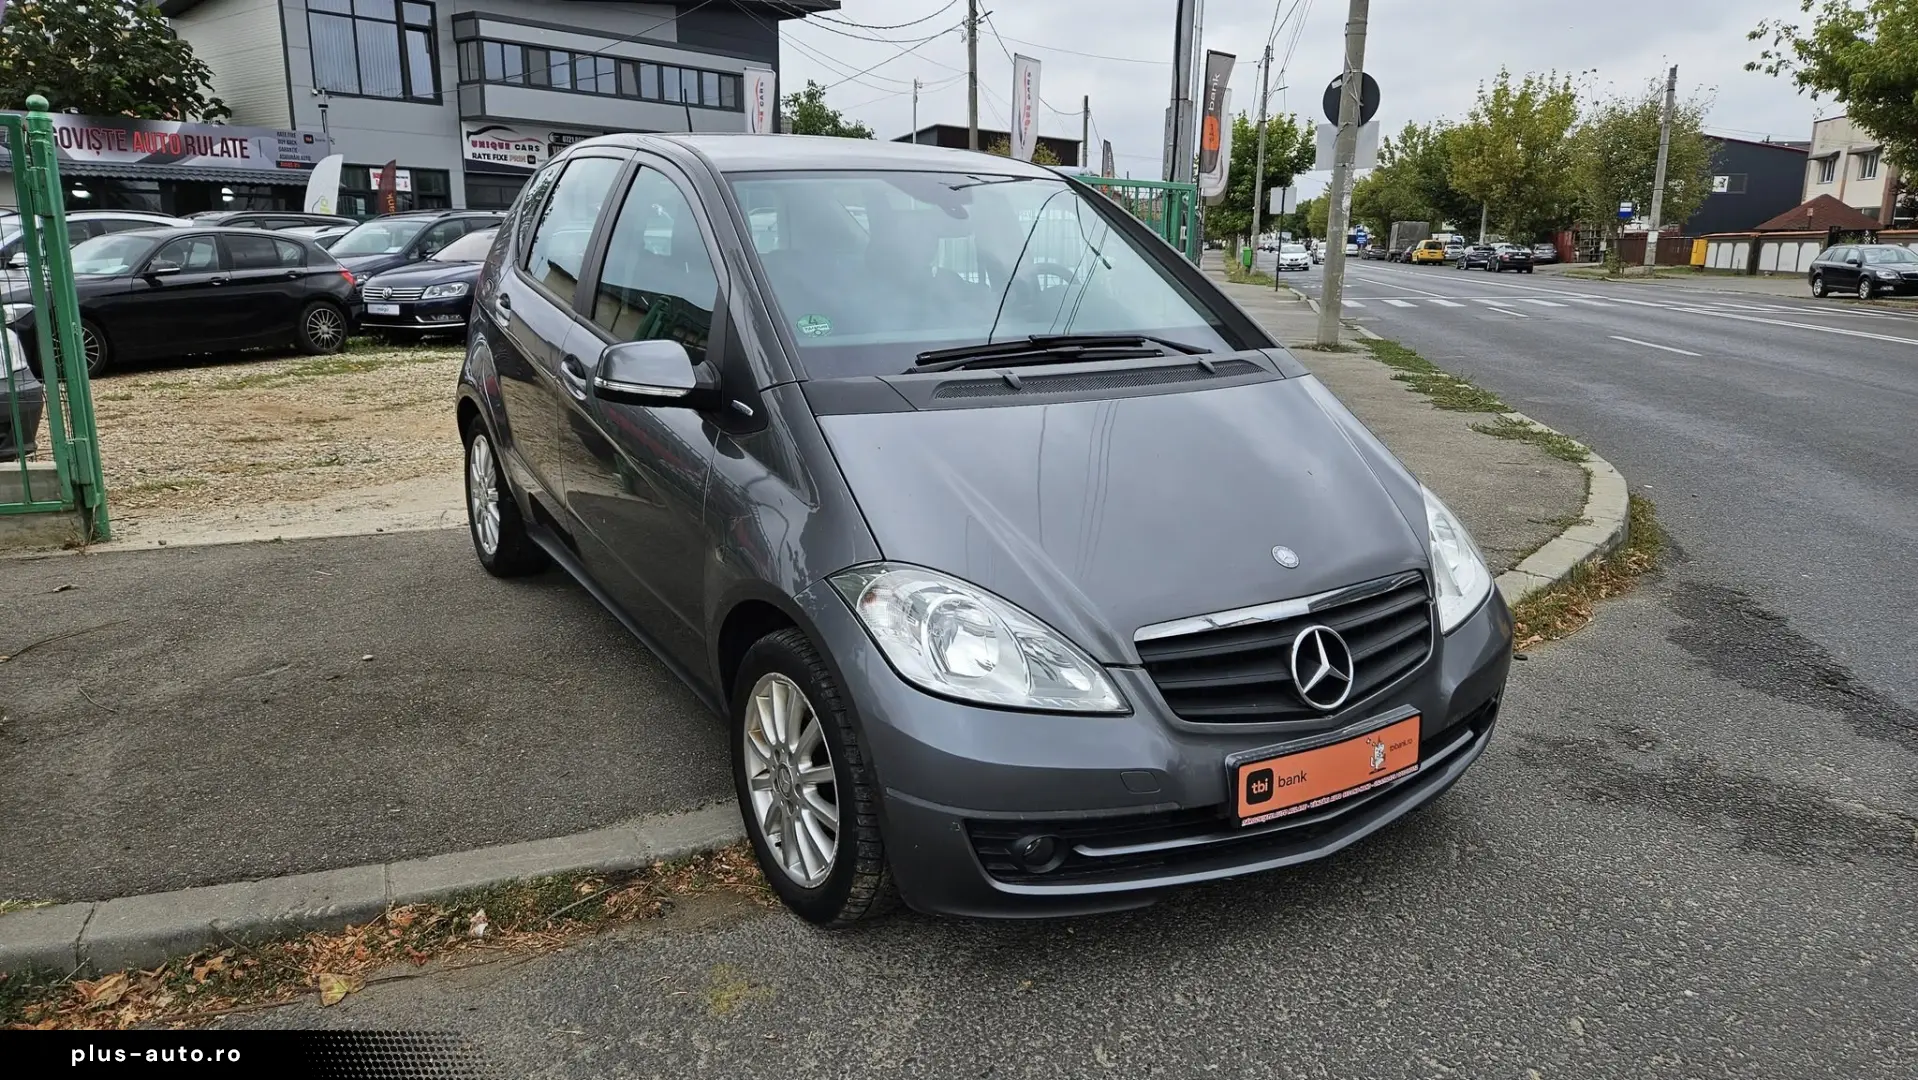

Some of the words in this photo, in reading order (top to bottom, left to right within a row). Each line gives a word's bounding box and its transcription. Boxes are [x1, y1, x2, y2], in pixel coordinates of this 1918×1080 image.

[1208, 73, 1220, 111] bank
[131, 131, 182, 155] AUTO
[184, 134, 250, 159] RULATE
[471, 140, 511, 151] UNIQUE
[515, 144, 540, 152] CARS
[472, 152, 491, 160] RATE
[493, 154, 508, 162] FIXE
[1251, 777, 1269, 795] tbi
[1278, 769, 1308, 788] bank
